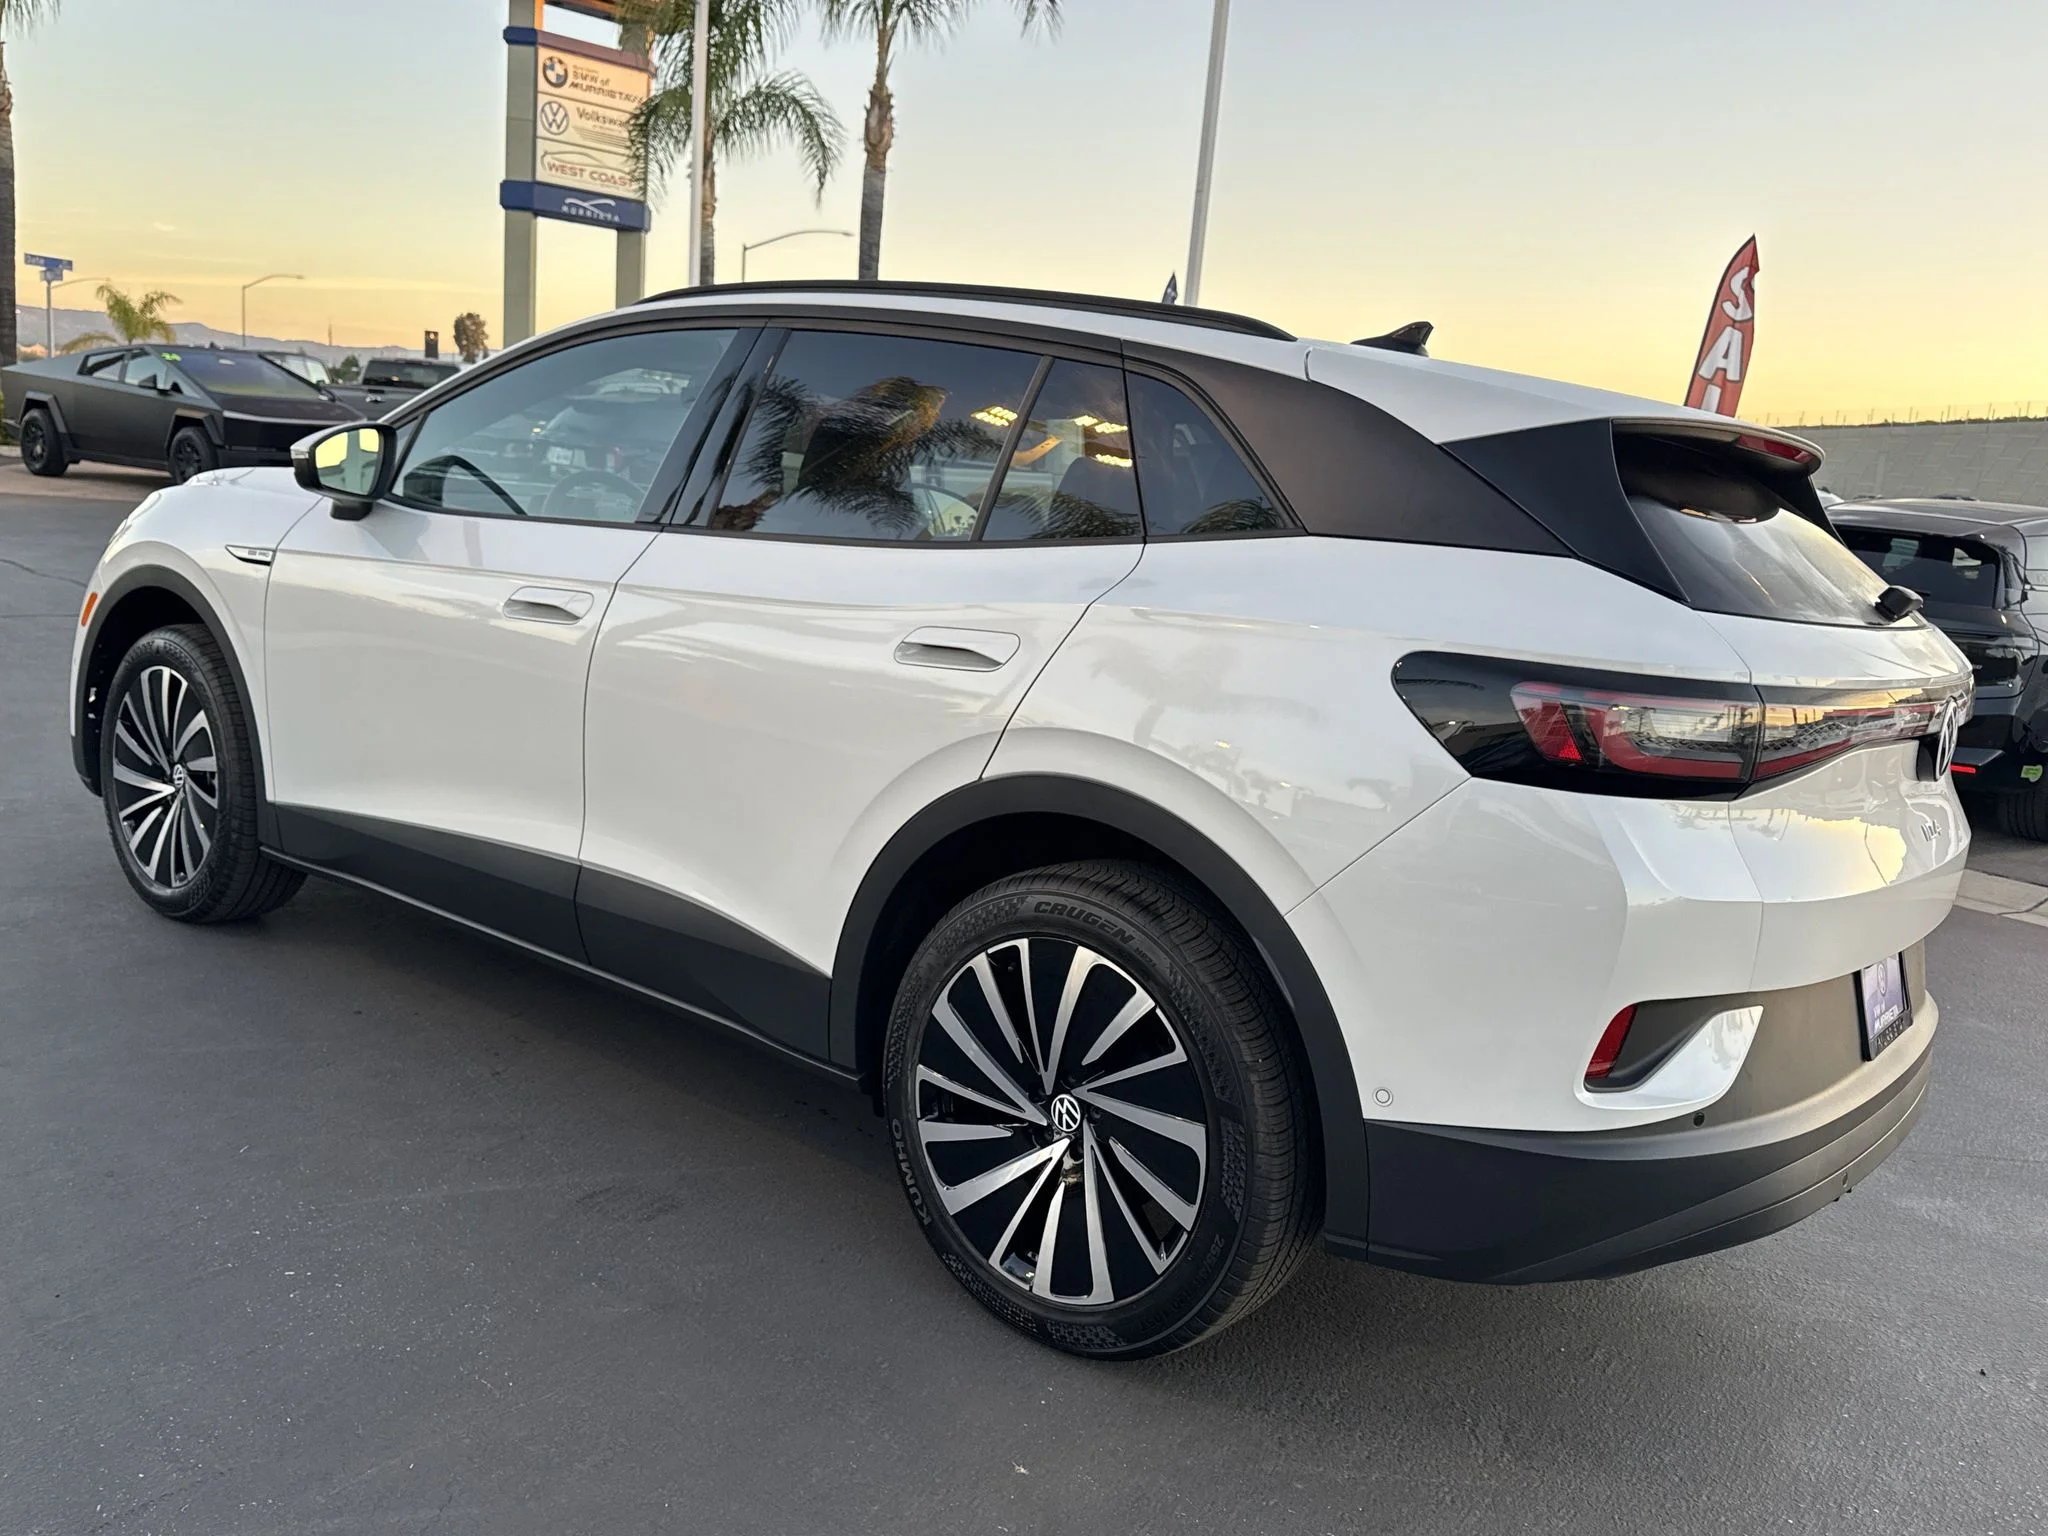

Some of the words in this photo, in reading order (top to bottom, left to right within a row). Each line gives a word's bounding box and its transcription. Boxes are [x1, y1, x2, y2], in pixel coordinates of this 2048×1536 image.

[547, 162, 587, 178] WEST
[588, 170, 635, 188] COAST
[1034, 901, 1136, 945] CRUGEN
[892, 1118, 933, 1226] KUMHO
